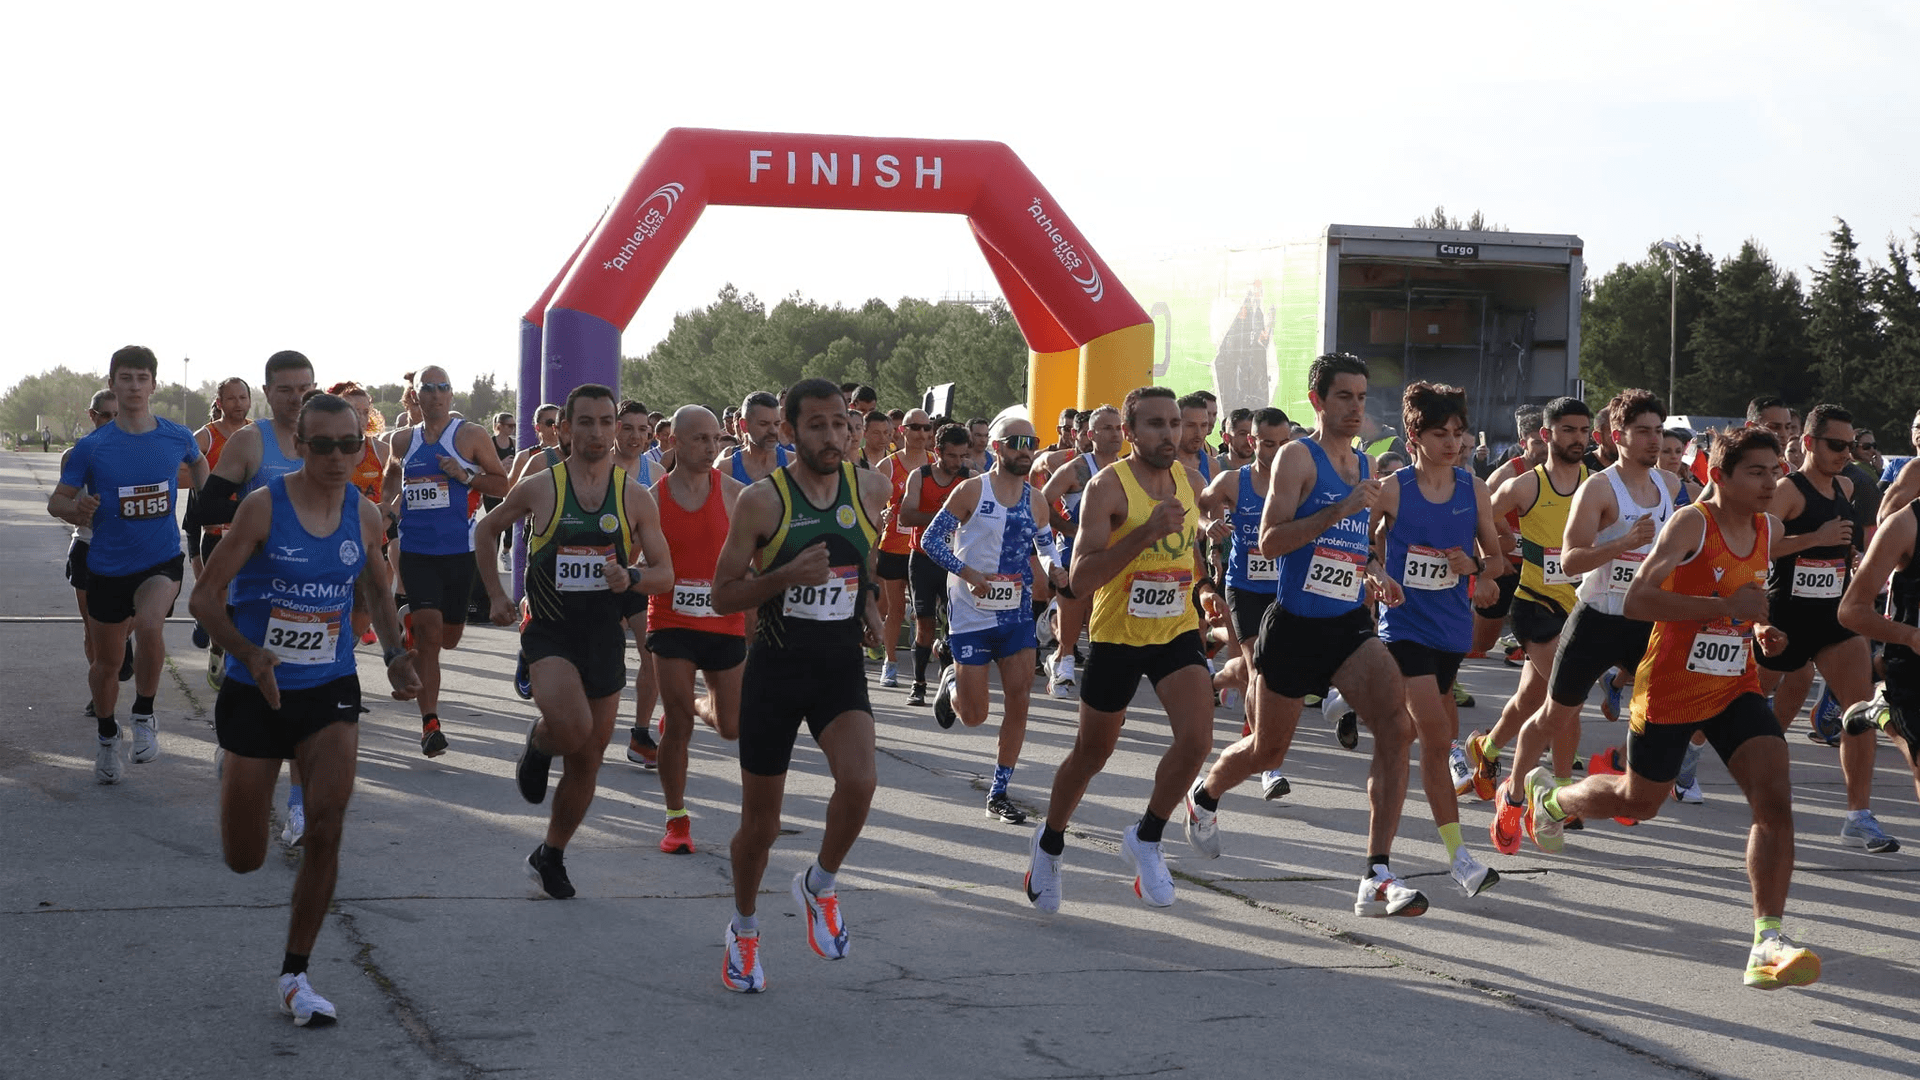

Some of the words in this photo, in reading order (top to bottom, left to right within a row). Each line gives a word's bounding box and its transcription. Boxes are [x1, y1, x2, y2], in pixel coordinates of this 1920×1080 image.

[750, 150, 942, 189] FINISH
[647, 215, 666, 239] MALTA
[1027, 205, 1082, 268] Athletics
[612, 207, 660, 271] Athletics
[1052, 246, 1074, 272] MALTA
[1440, 244, 1474, 256] Cargo
[407, 488, 437, 501] 3196
[123, 498, 168, 517] 8155
[1333, 518, 1369, 536] ARMI
[559, 562, 603, 579] 3018
[1250, 560, 1278, 572] 321
[1310, 563, 1354, 587] 3226
[1408, 561, 1448, 579] 3173
[1546, 561, 1562, 575] 31
[1612, 566, 1634, 582] 35
[1796, 572, 1834, 588] 3020
[788, 586, 842, 606] 3017
[1132, 587, 1176, 606] 3028
[269, 628, 324, 650] 3222
[1694, 641, 1740, 662] 3007
